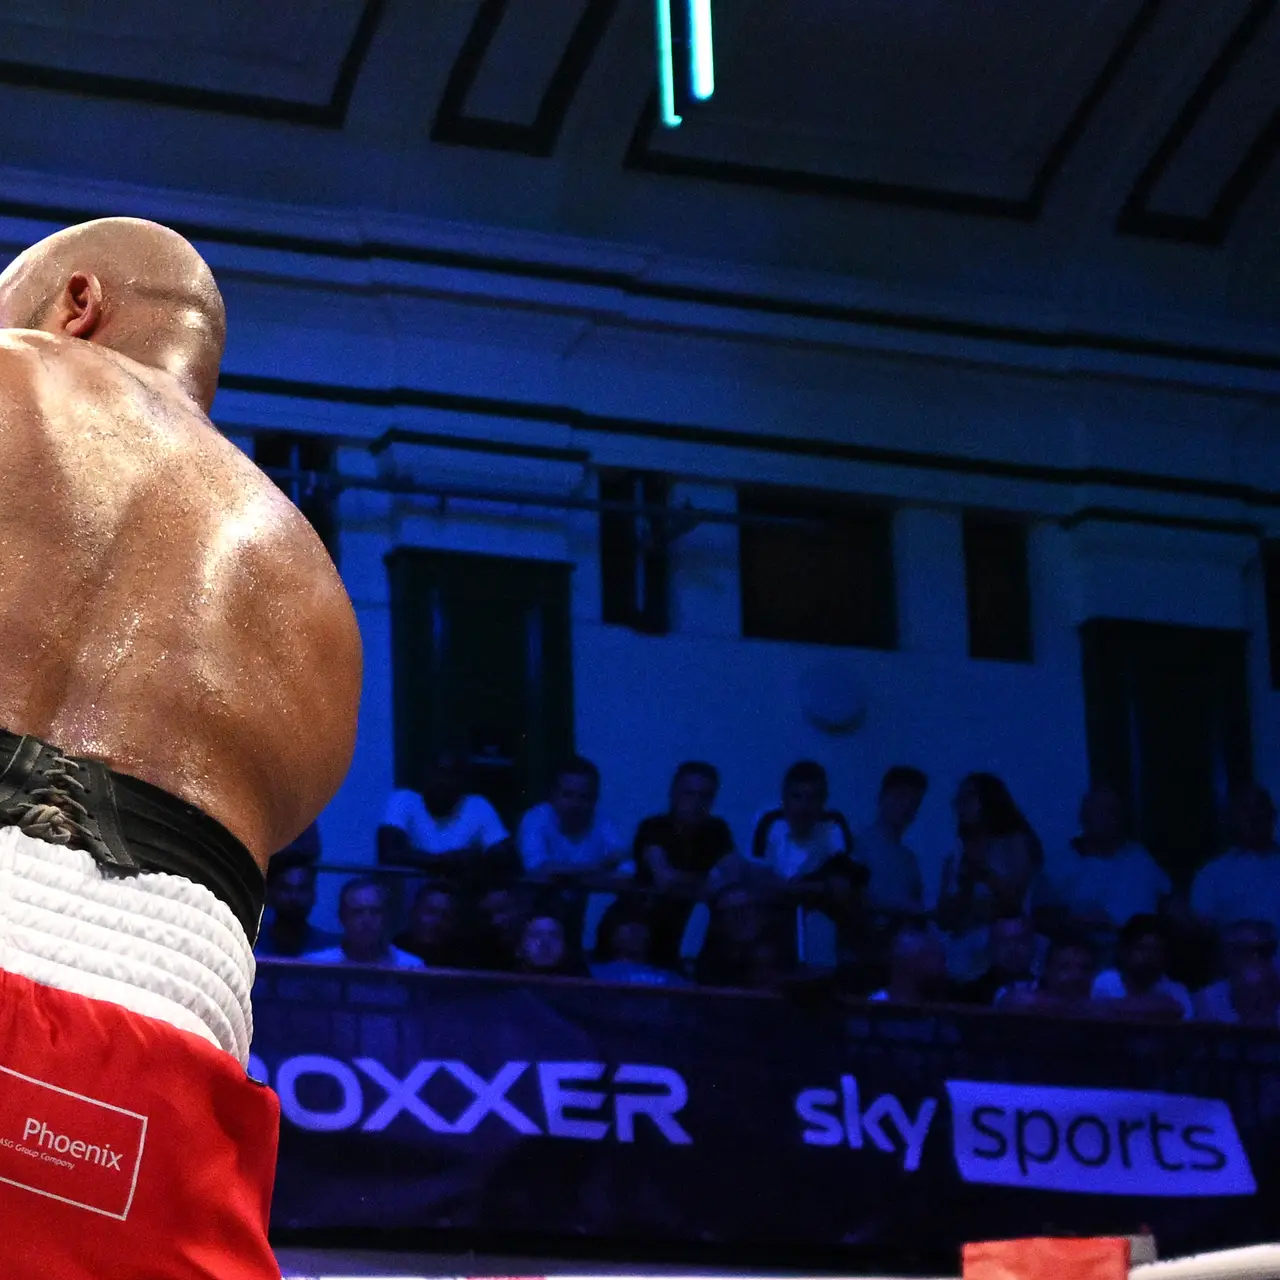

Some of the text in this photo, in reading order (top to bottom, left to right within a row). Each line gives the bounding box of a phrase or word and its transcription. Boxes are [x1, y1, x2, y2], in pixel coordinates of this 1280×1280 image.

[22, 1117, 124, 1172] Phoenix
[795, 1073, 1230, 1180] sky sports
[14, 1142, 40, 1159] Group
[40, 1151, 76, 1170] Company
